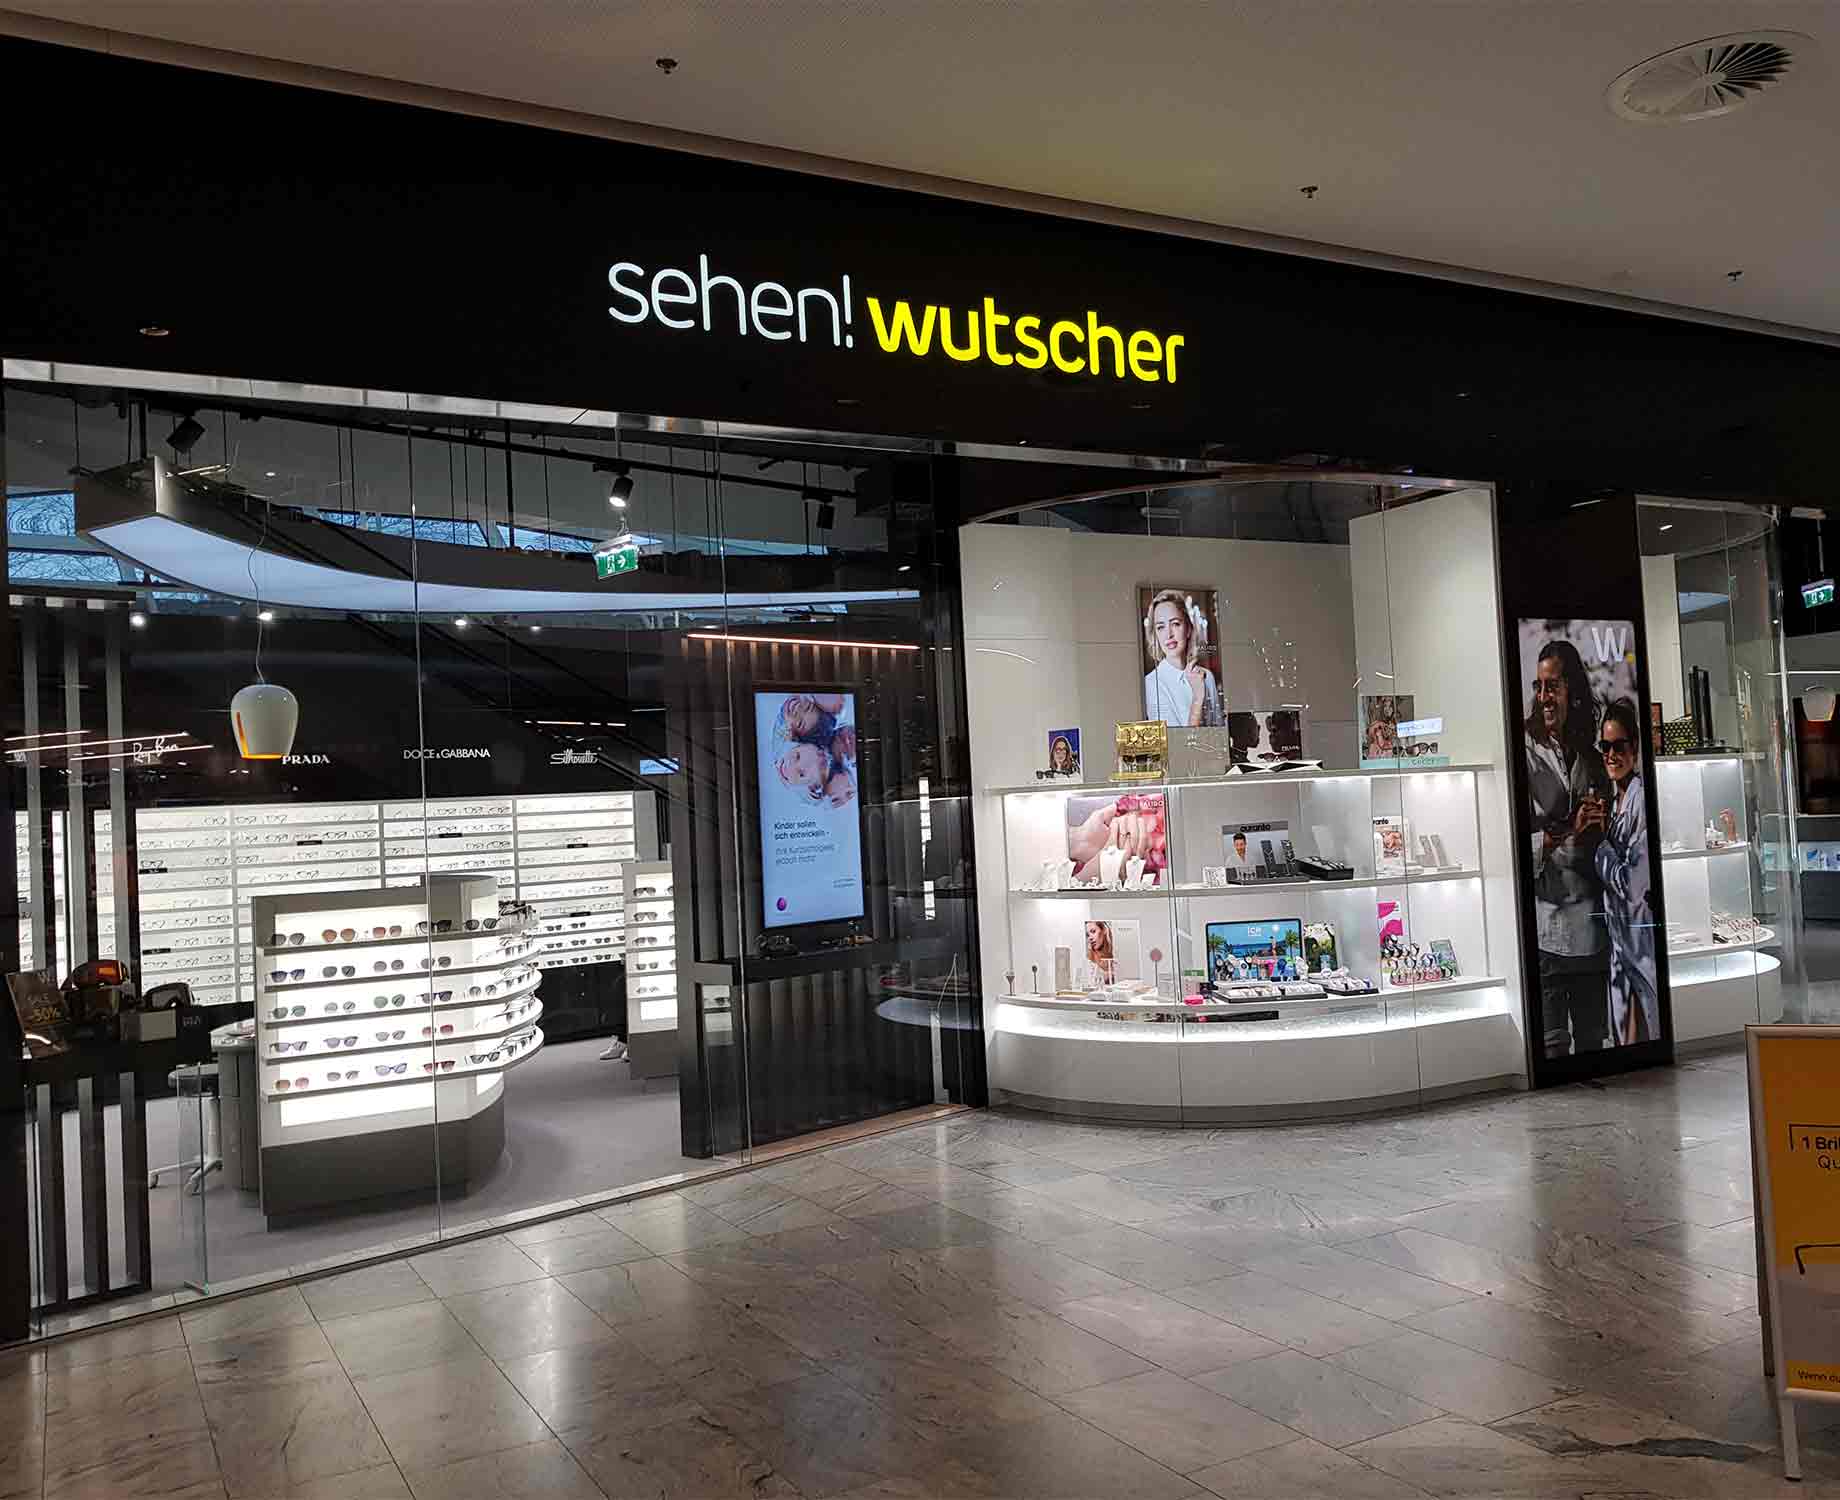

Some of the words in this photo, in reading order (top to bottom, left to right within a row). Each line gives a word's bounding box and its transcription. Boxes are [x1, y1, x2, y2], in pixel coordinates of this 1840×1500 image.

[608, 253, 854, 348] sehen!
[867, 296, 1185, 384] wutscher
[281, 754, 331, 765] PRADA
[1801, 1135, 1810, 1150] 1
